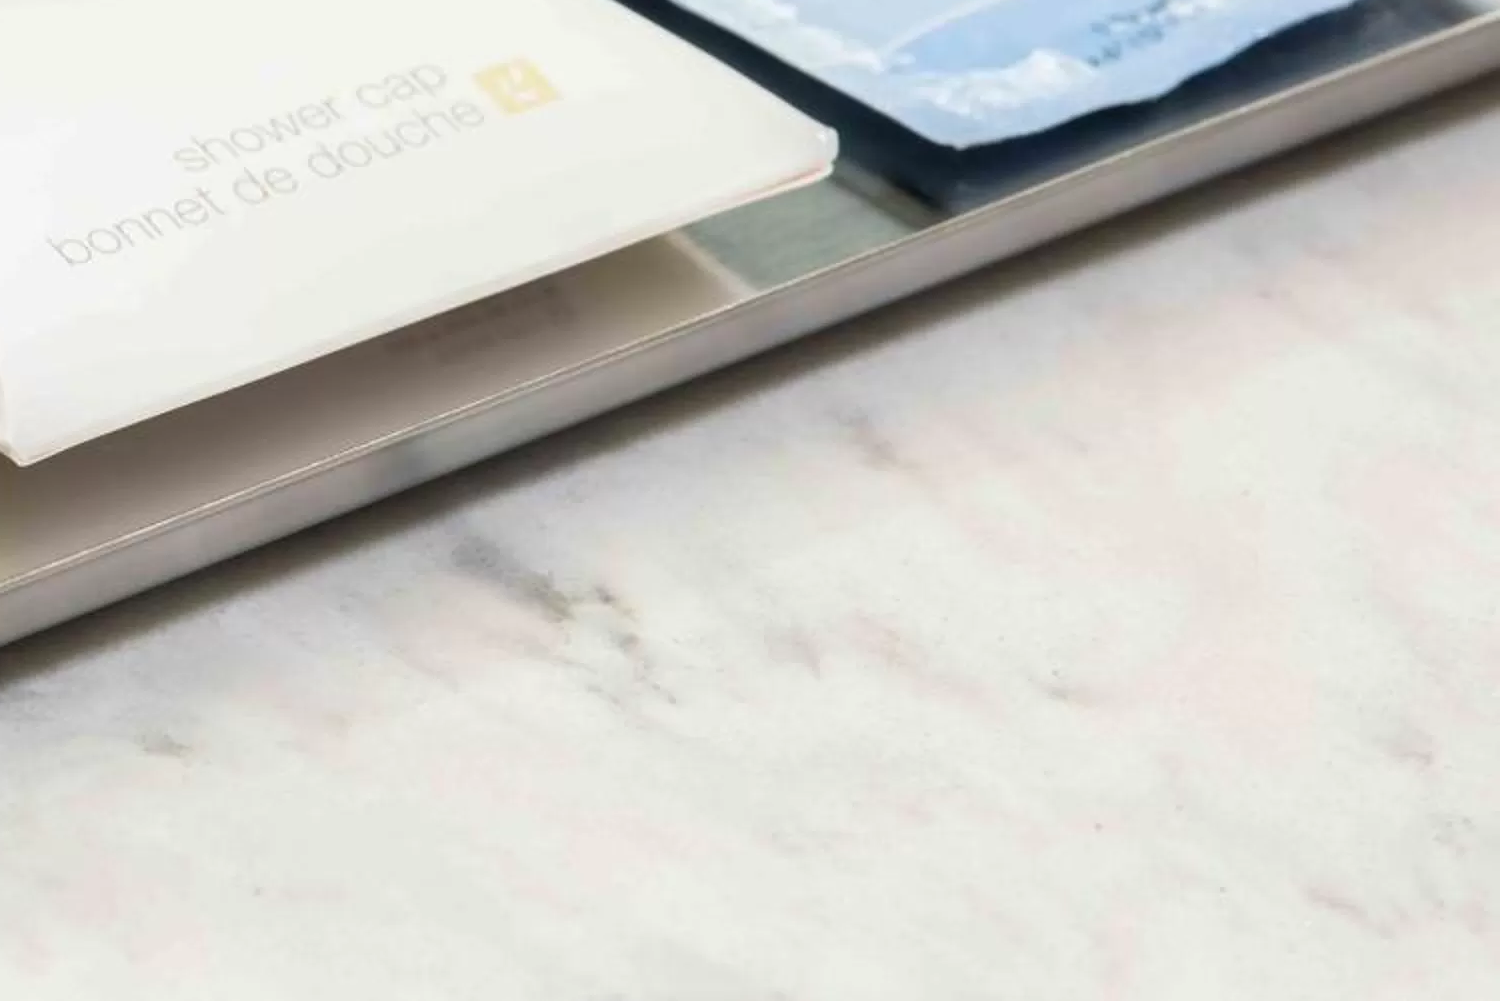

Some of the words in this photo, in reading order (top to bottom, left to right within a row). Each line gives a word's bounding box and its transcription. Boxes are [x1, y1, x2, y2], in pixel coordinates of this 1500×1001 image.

[46, 185, 226, 267] bonnet
[232, 164, 299, 200] de
[306, 97, 485, 178] douche
[172, 94, 346, 173] shower
[355, 62, 448, 111] cap
